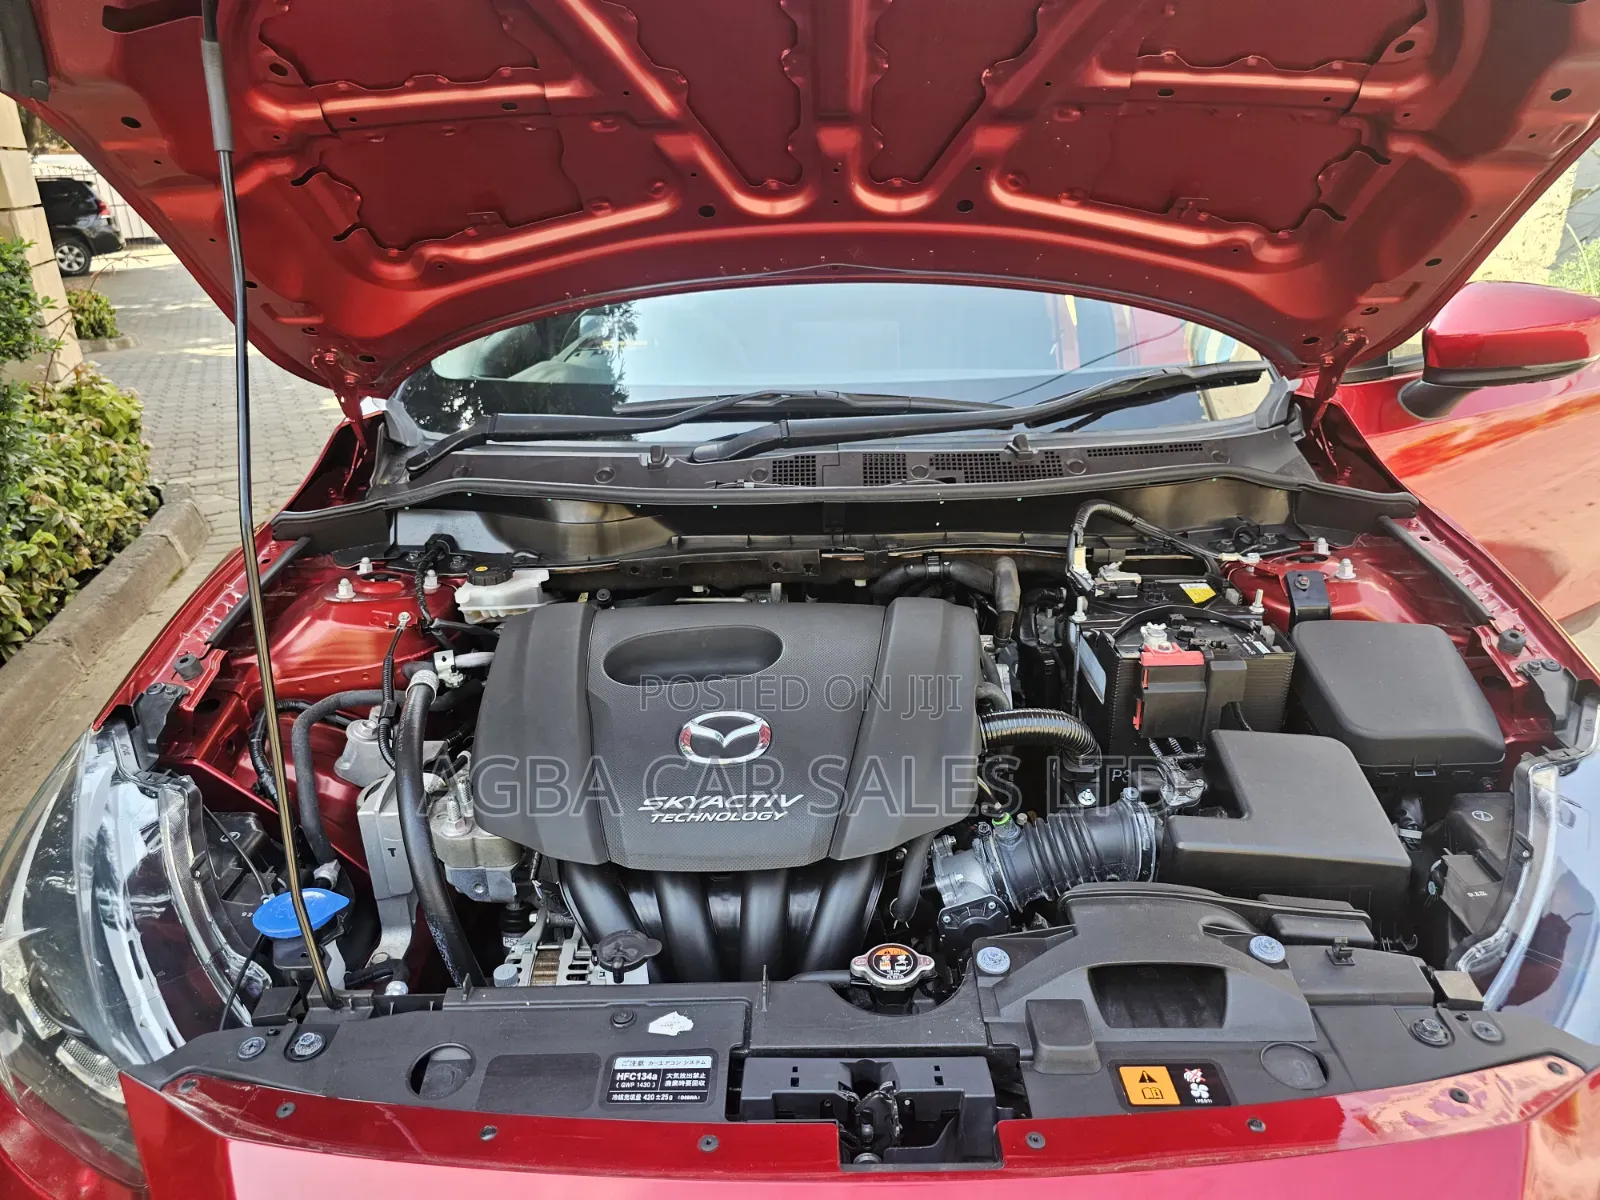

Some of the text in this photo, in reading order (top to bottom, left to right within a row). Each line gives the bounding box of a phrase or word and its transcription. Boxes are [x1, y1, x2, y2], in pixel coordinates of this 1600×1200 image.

[638, 794, 804, 811] SKYACTIV
[651, 811, 788, 823] TECHNOLOGY
[616, 1072, 658, 1081] HFC134a
